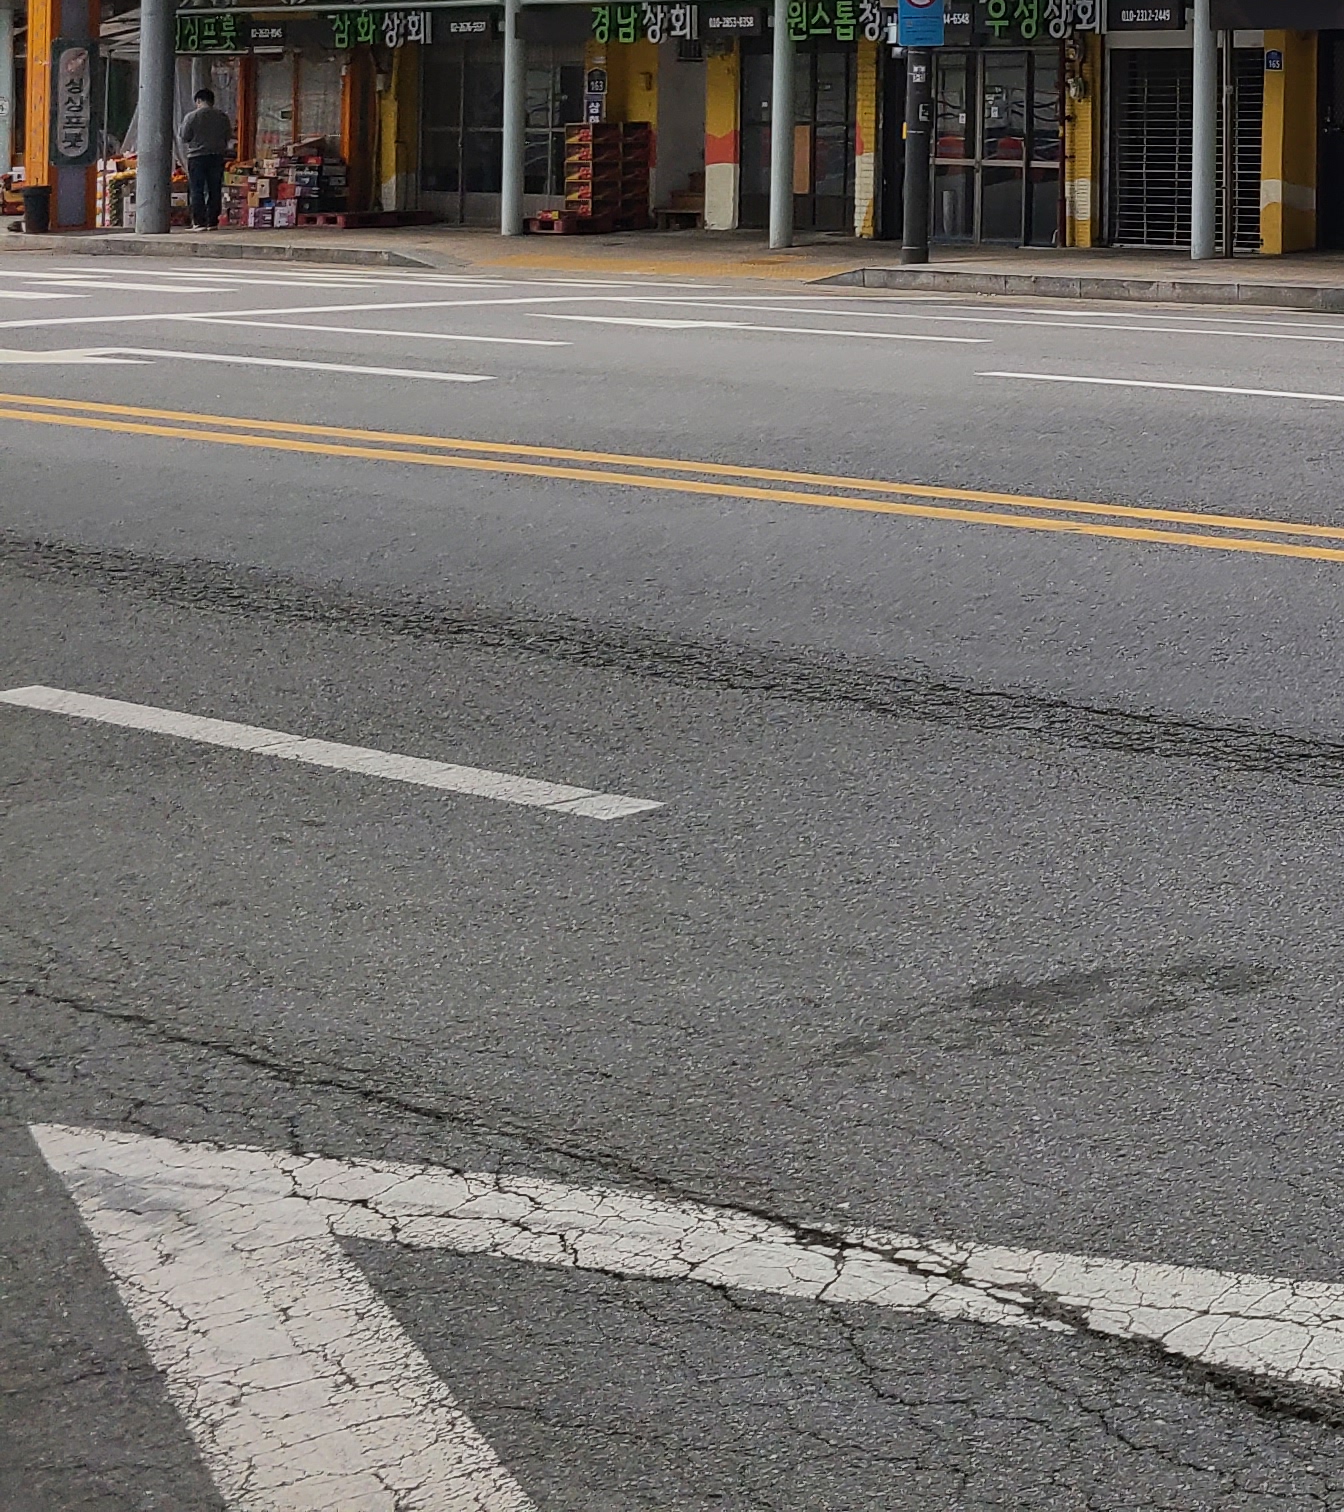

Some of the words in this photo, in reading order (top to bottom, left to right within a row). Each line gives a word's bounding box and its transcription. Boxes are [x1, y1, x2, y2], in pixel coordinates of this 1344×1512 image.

[332, 10, 432, 48] 삼화상회
[591, 2, 698, 44] 경남상회
[1121, 8, 1171, 22] 010-2312-2449
[1268, 59, 1280, 69] 165
[62, 78, 86, 150] 싱싱프룻
